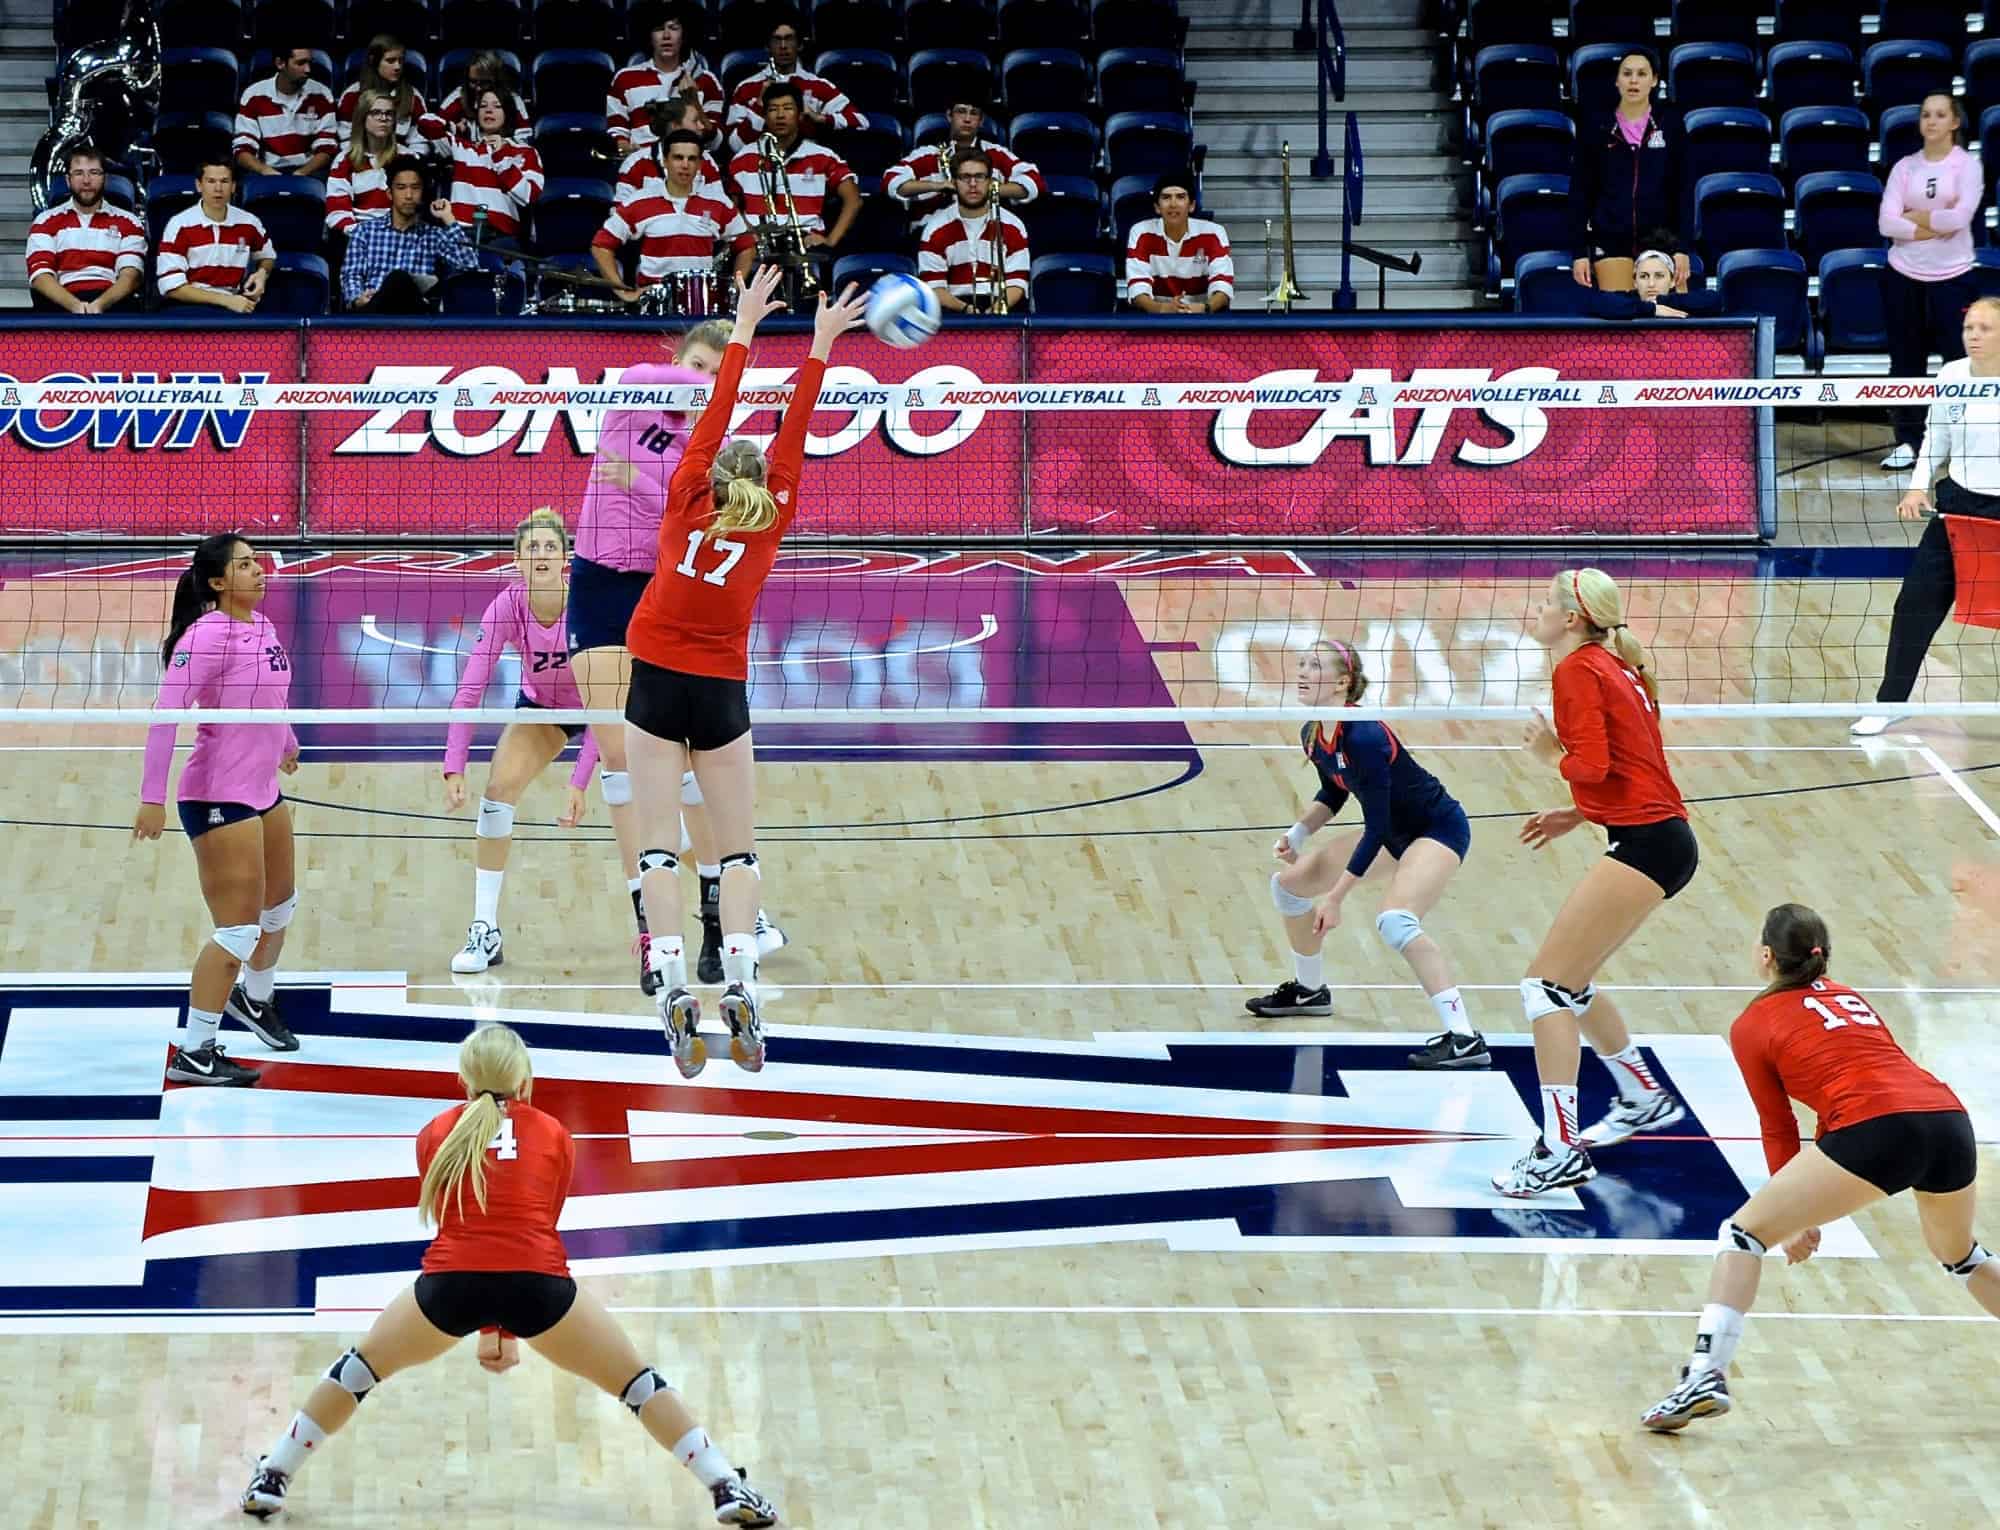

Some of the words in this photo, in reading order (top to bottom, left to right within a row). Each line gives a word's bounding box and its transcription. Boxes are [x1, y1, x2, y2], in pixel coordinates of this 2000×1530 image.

[1926, 177, 1937, 199] 5
[0, 372, 269, 448] OWN
[335, 366, 626, 456] ZON
[1214, 367, 1560, 466] CATS
[636, 422, 676, 455] 18
[675, 529, 747, 588] 17
[533, 651, 568, 673] 22
[1803, 993, 1880, 1031] 19
[486, 1118, 518, 1160] 4
